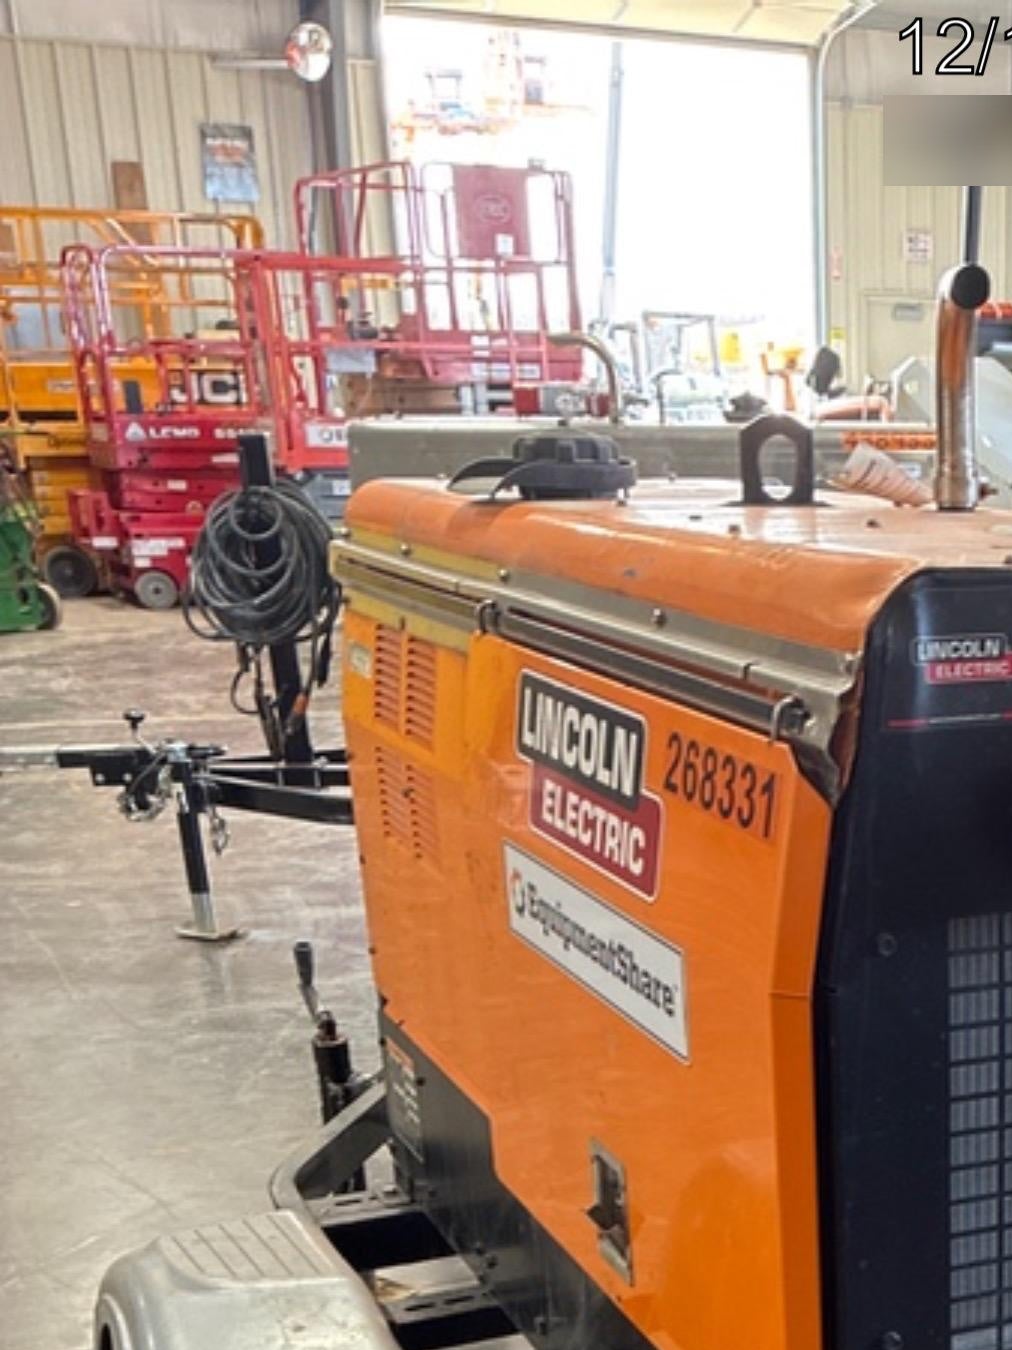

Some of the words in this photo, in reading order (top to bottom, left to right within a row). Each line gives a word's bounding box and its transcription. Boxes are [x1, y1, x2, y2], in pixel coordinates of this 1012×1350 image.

[918, 639, 1001, 661] LINCOLN
[935, 661, 1012, 680] ELECTRIC
[521, 685, 638, 798] LINCOLN
[662, 730, 777, 839] 268331
[541, 779, 647, 872] ELECTRIC
[525, 881, 676, 1018] EquipmentShare
